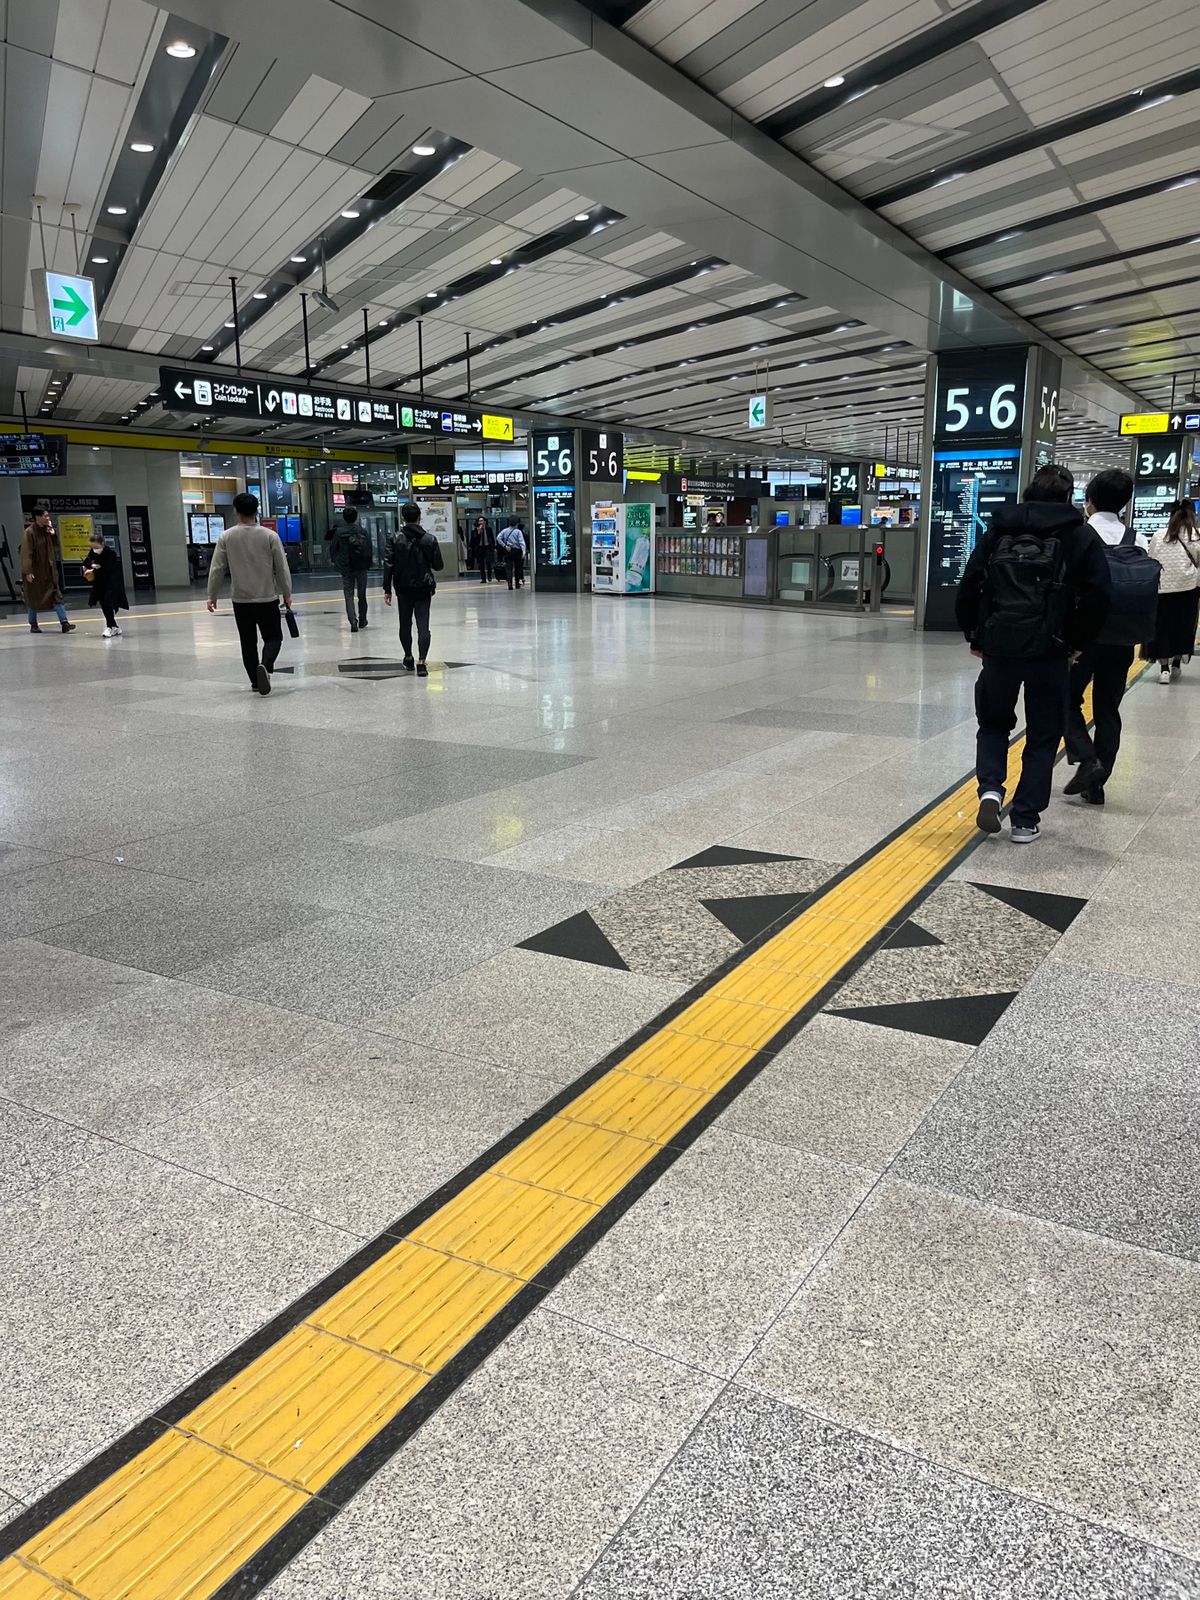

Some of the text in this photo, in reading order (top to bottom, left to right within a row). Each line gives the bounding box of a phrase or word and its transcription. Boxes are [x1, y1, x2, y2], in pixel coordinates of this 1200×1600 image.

[213, 383, 254, 396] コインロッカー
[214, 393, 247, 404] Coin Lockers
